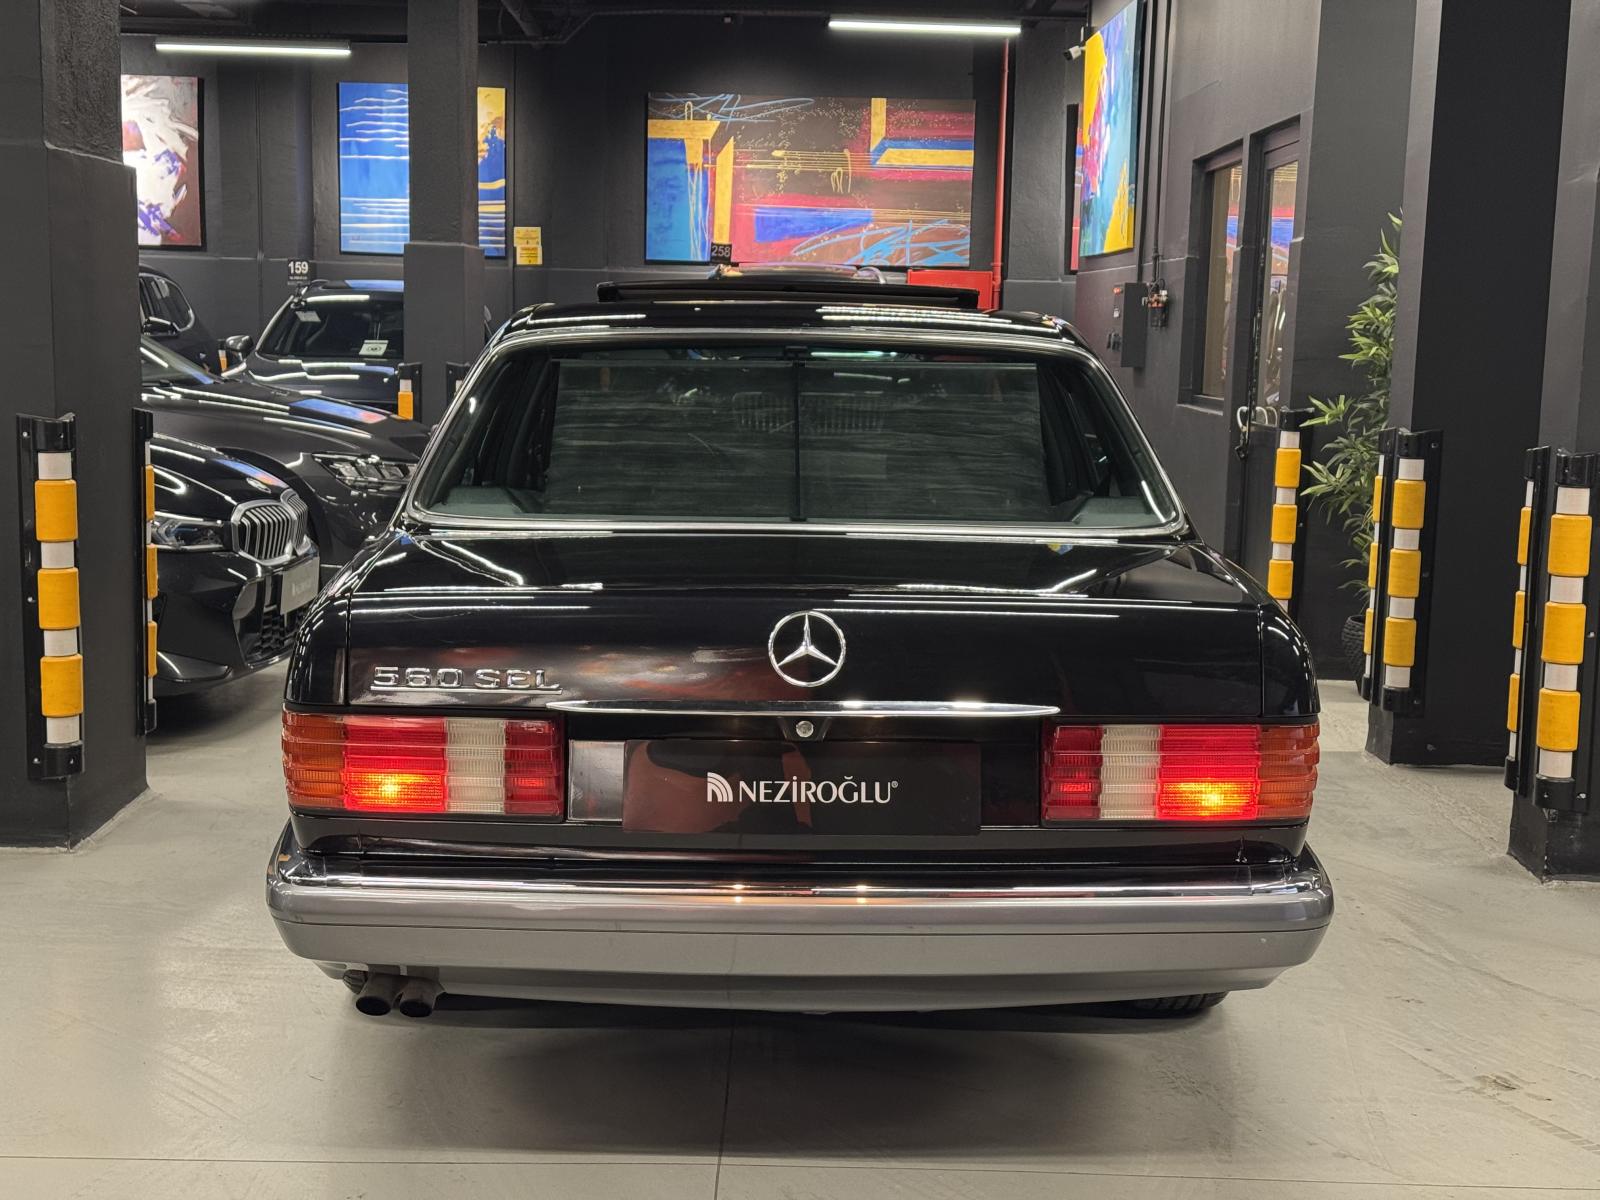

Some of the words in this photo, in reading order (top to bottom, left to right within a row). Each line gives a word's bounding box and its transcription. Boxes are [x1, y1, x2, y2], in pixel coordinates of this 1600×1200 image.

[711, 245, 731, 257] 258
[288, 261, 309, 274] 159
[373, 666, 464, 688] 560
[474, 668, 560, 689] SEL
